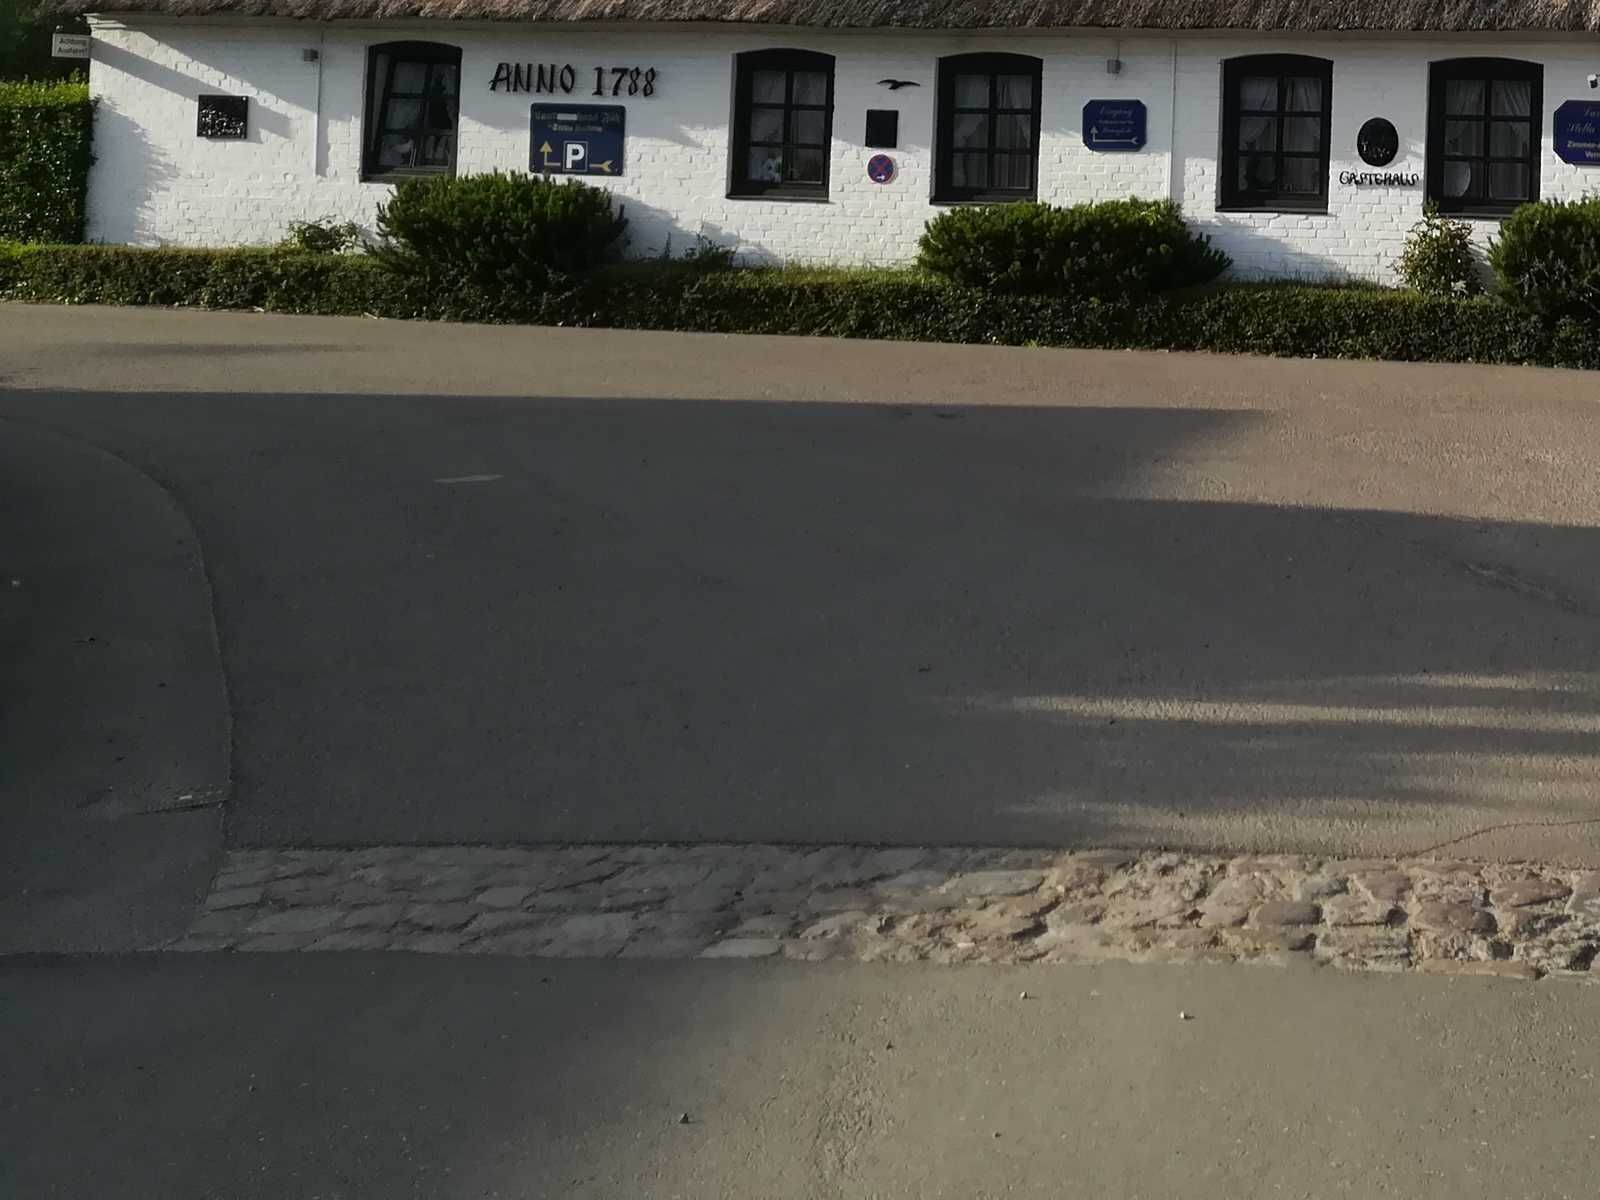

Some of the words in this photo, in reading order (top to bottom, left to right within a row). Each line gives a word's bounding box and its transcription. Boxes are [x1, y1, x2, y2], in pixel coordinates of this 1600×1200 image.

[488, 63, 576, 93] ANNO
[592, 67, 657, 97] 1788
[566, 143, 585, 169] P
